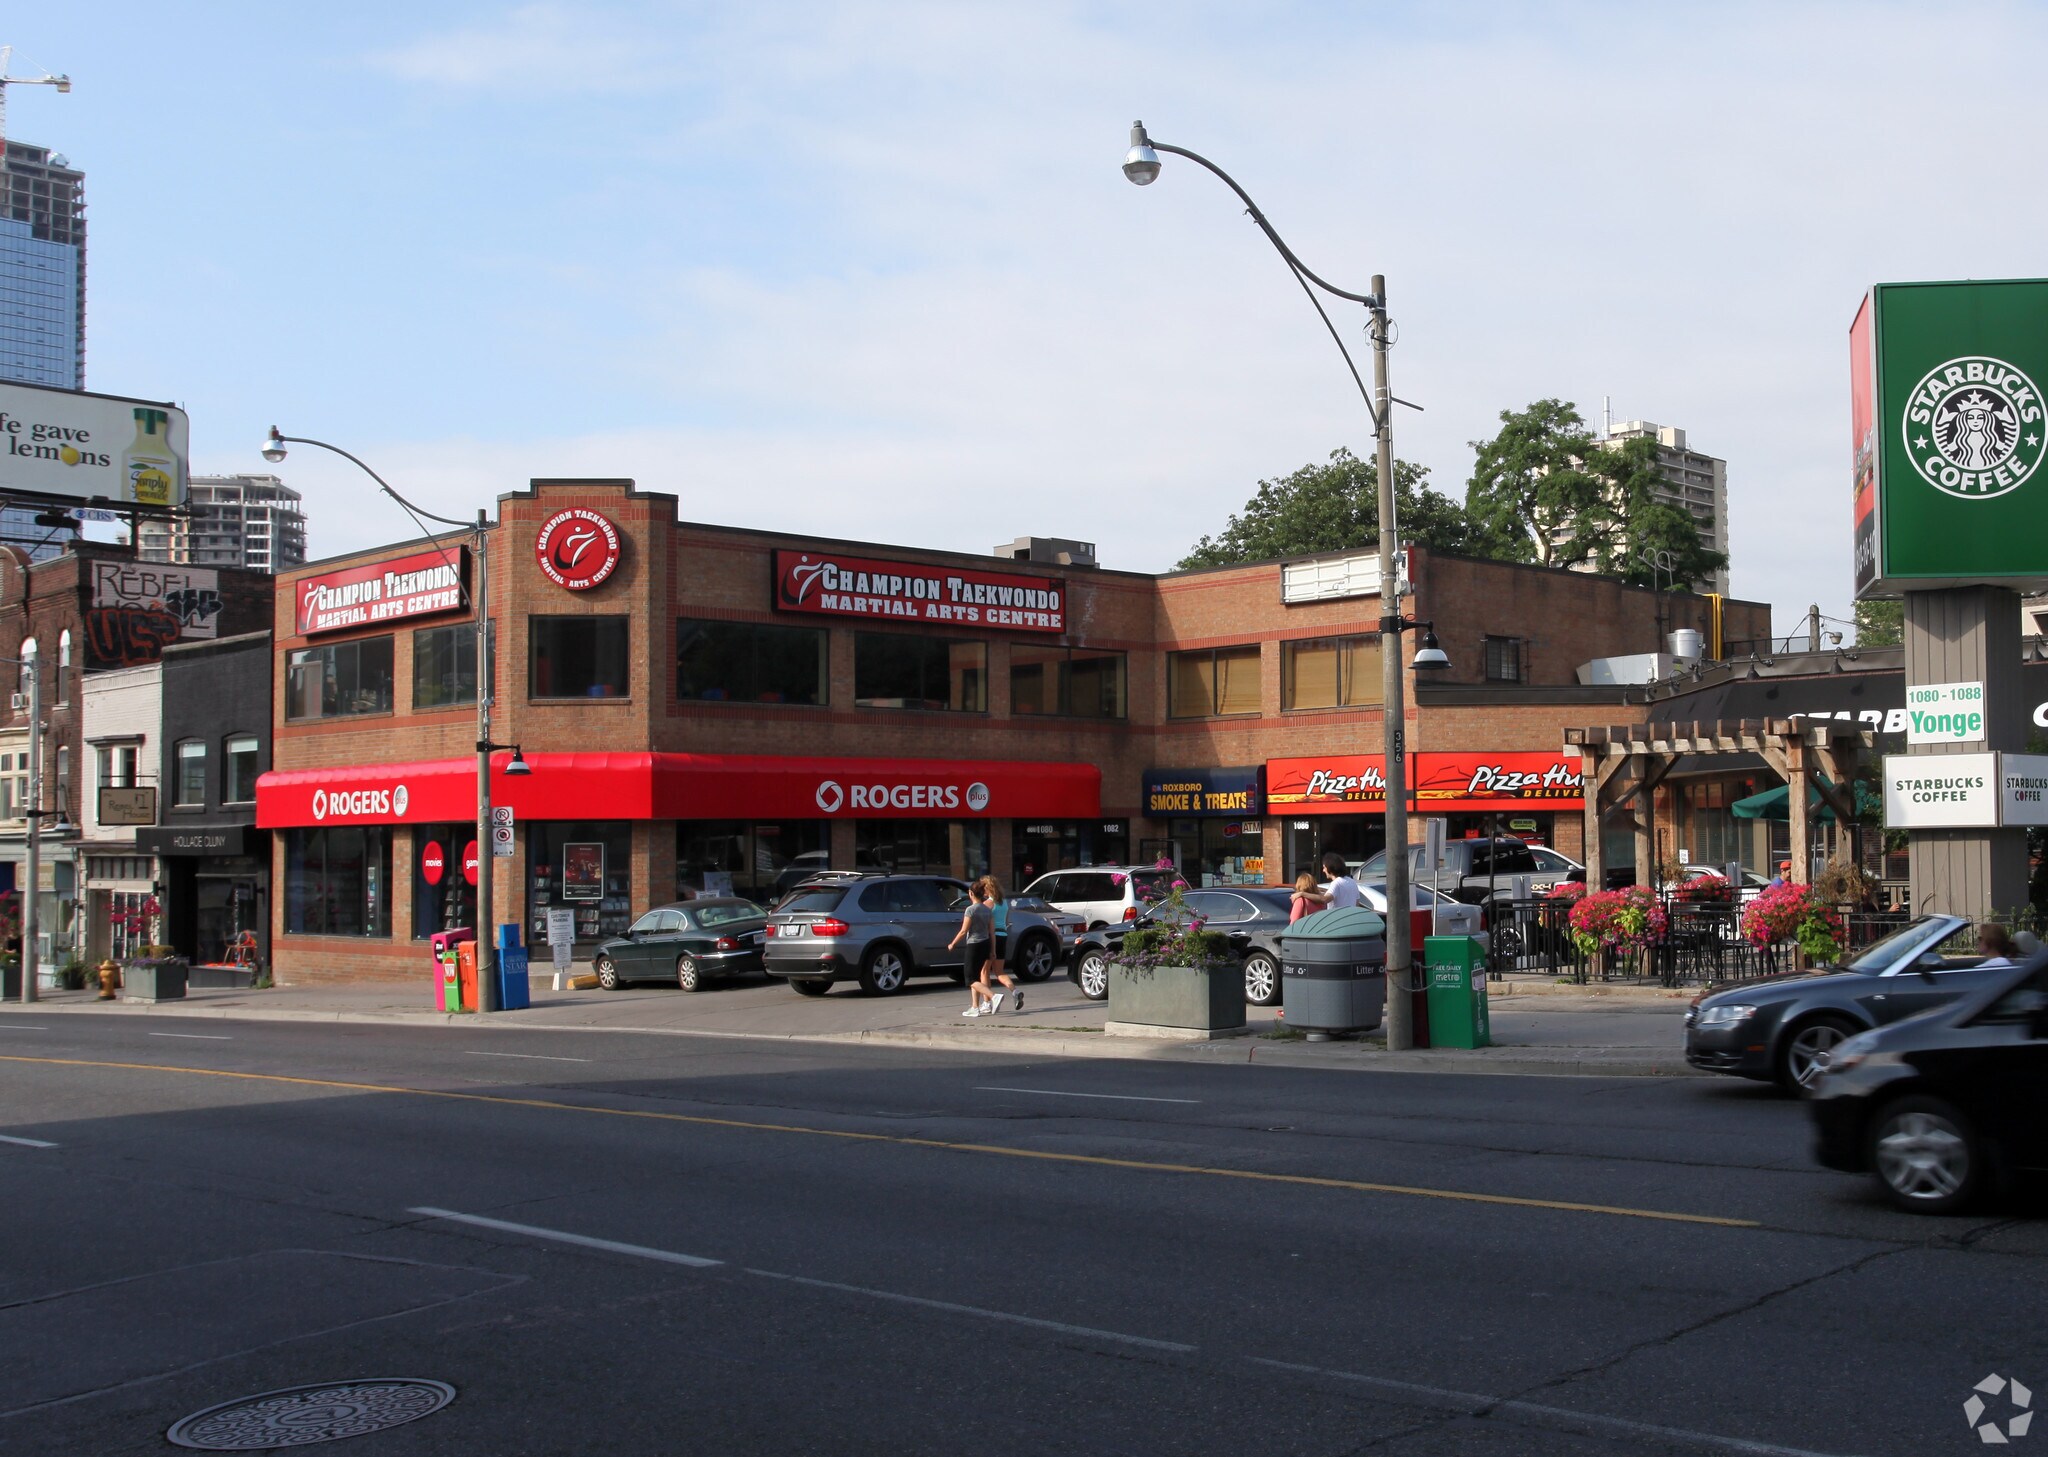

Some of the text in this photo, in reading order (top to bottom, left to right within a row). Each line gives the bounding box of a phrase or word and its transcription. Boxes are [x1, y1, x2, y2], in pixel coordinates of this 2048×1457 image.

[1910, 362, 2041, 426] STARBUCKS
[31, 423, 90, 443] gave
[1924, 454, 2028, 492] COFFEE
[88, 509, 112, 520] CBS
[538, 510, 617, 550] CHAMPION TAEKWONDO
[540, 556, 615, 587] MARTIAL ARTS CENTRE
[318, 563, 458, 611] CHAMPION TAEKWONDO
[822, 562, 1060, 611] CHAMPION TAEKWONDO
[317, 589, 459, 628] MARTIAL ARTS CENTRE
[821, 594, 1062, 628] MARTIAL ARTS CENTRE
[1909, 690, 1939, 703] 1080
[1950, 687, 1982, 700] 1088
[1910, 710, 1982, 737] Yonge
[1306, 766, 1386, 797] Pizza Hu
[1468, 763, 1585, 793] Pizza Hu
[1896, 777, 1984, 791] STARBUCKS
[2006, 778, 2048, 789] STARBUCKS
[850, 784, 987, 809] ROGERS plus
[1162, 783, 1202, 792] ROXBORO
[1523, 789, 1585, 797] DELIVE
[1912, 790, 1968, 803] COFFEE
[2015, 791, 2041, 802] COFFEE
[329, 789, 390, 816] ROGERS
[1150, 793, 1189, 811] SMOKE
[1193, 793, 1202, 810] &
[1205, 791, 1247, 810] TREATS
[1243, 821, 1261, 833] ATM
[425, 858, 442, 866] movies
[466, 860, 479, 869] gam
[1244, 861, 1263, 869] ATM
[505, 962, 527, 970] STAR
[1356, 965, 1374, 975] Litter
[1435, 973, 1460, 982] metro
